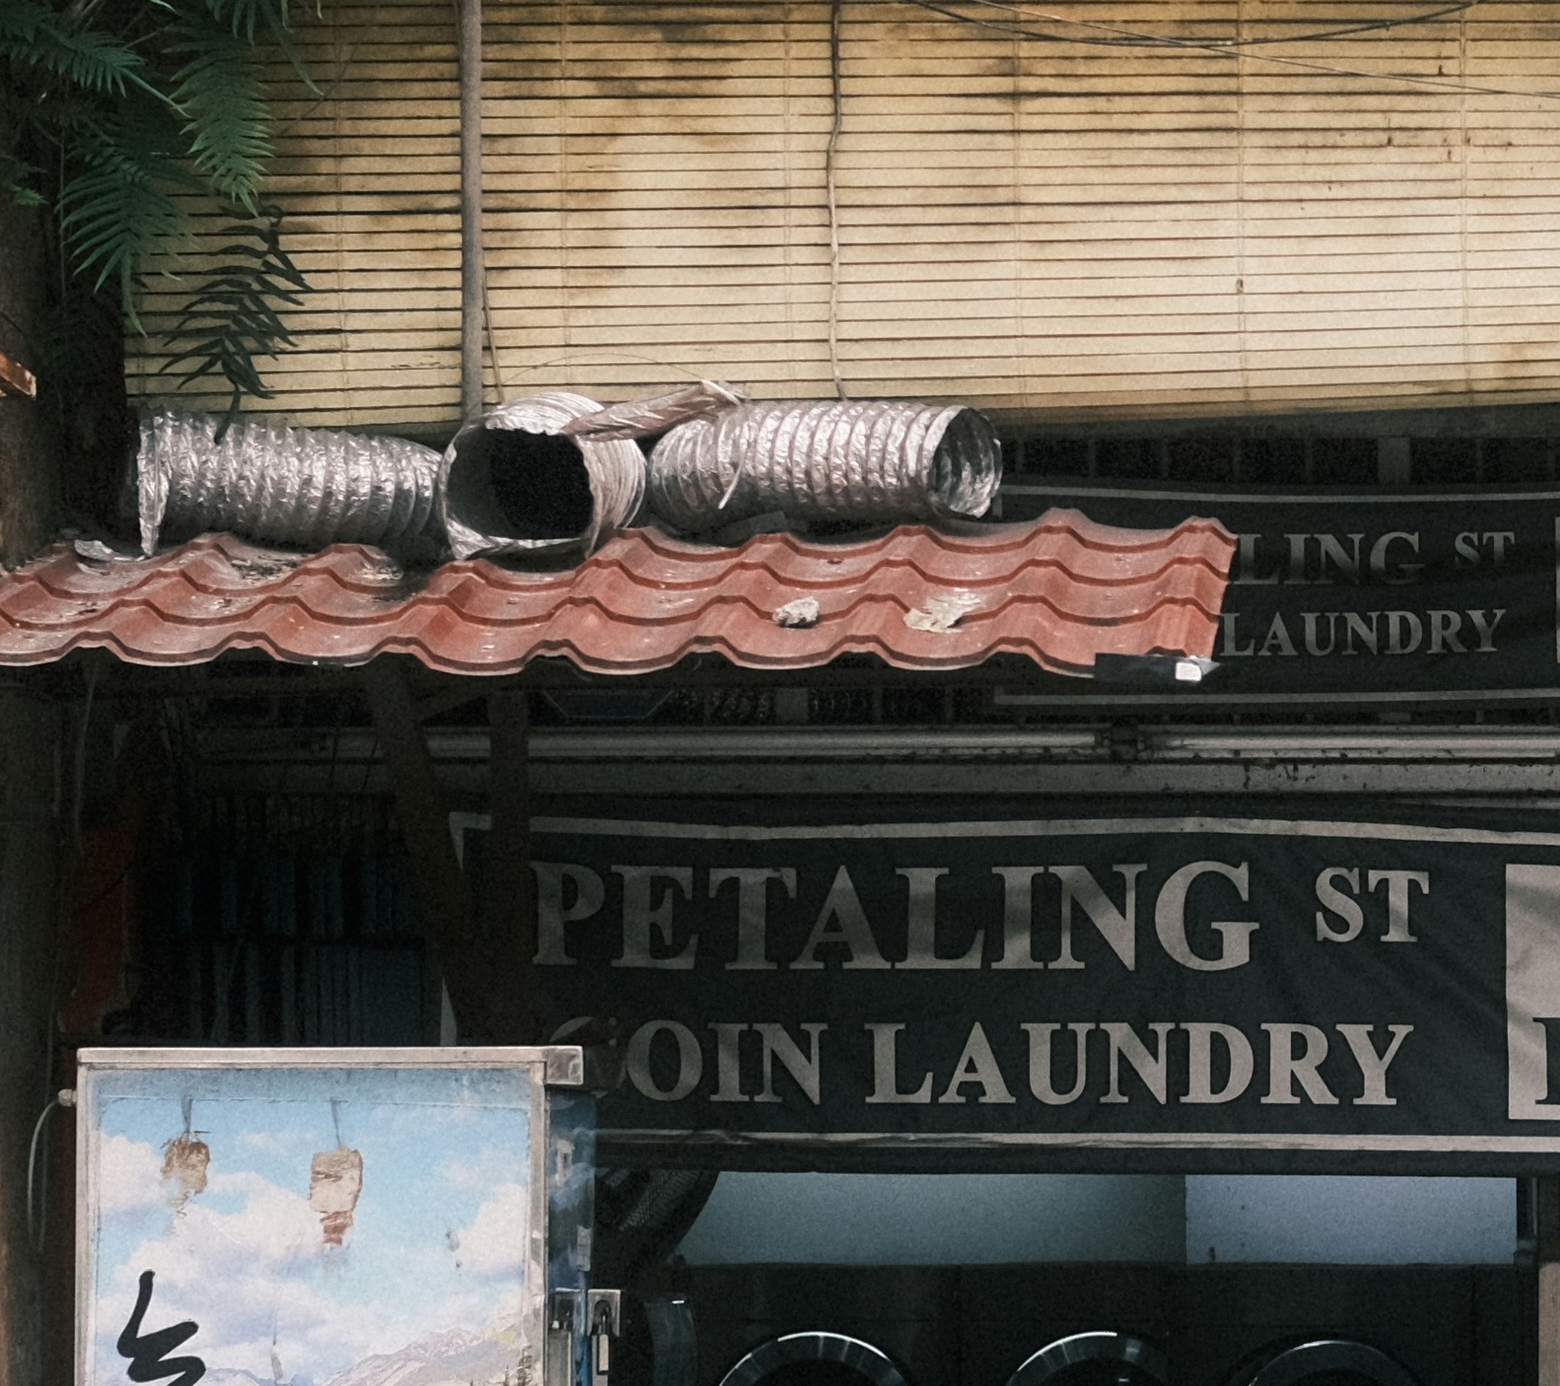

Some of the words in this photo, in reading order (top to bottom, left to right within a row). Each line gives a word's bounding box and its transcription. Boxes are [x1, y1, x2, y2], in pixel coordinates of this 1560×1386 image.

[1226, 530, 1426, 586] LING
[1454, 531, 1516, 570] ST
[1218, 607, 1508, 659] LAUNDRY
[530, 860, 1261, 972] PETALING
[1314, 868, 1430, 945] ST
[864, 1021, 1414, 1107] LAUNDRY
